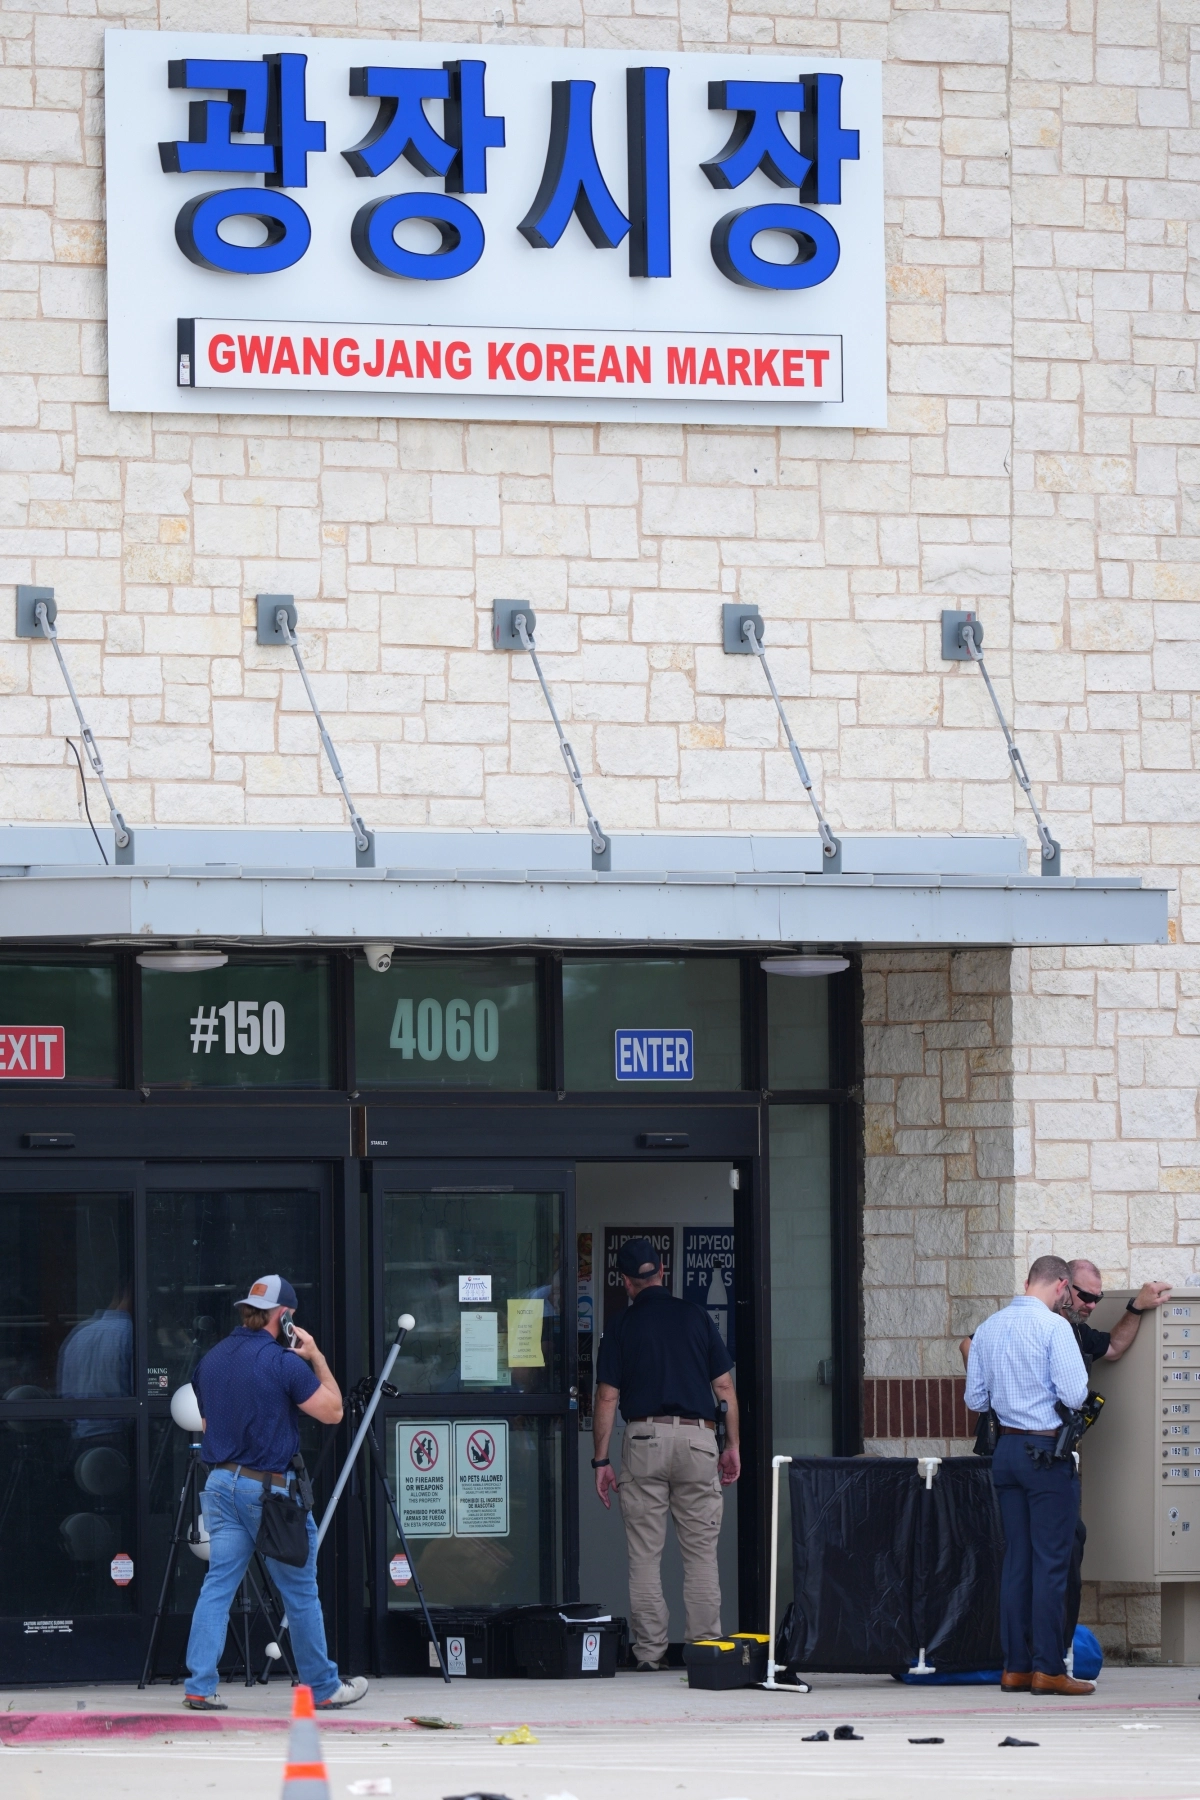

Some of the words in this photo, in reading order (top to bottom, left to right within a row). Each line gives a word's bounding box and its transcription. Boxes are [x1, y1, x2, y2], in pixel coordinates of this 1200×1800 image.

[158, 53, 860, 290] 광장시장
[208, 334, 471, 380] GWANGJANG
[488, 342, 651, 383] KOREAN
[667, 347, 830, 387] MARKET
[190, 1001, 285, 1055] #150
[390, 998, 499, 1061] 4060
[620, 1037, 688, 1072] ENTER
